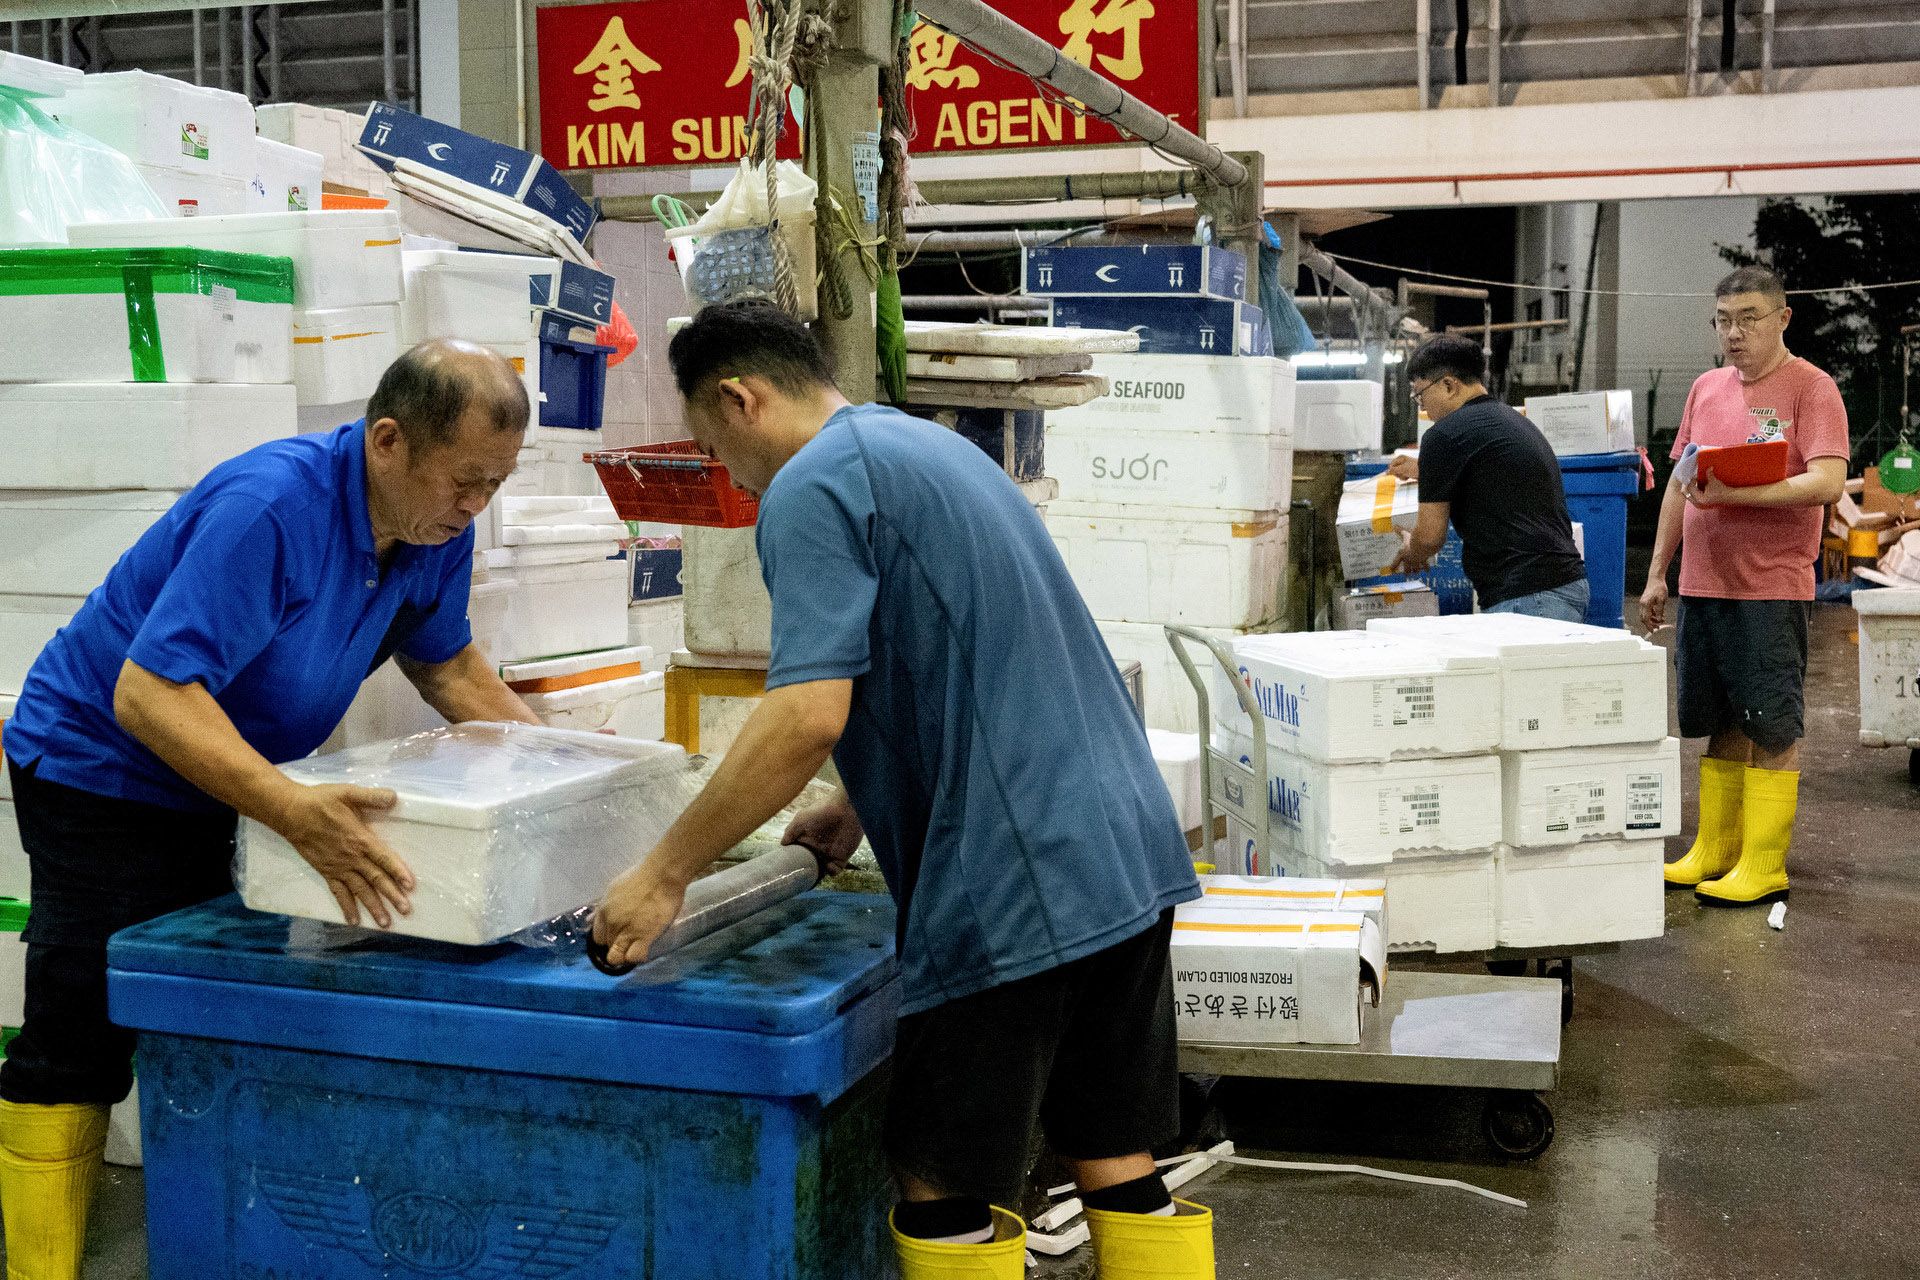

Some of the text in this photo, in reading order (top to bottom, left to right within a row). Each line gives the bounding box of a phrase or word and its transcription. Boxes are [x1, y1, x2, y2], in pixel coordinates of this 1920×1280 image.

[567, 121, 646, 167] KIM
[933, 95, 1087, 148] AGENT
[1113, 380, 1186, 400] SEAFOOD
[1177, 970, 1293, 985] FROZEN BOILED CLAM
